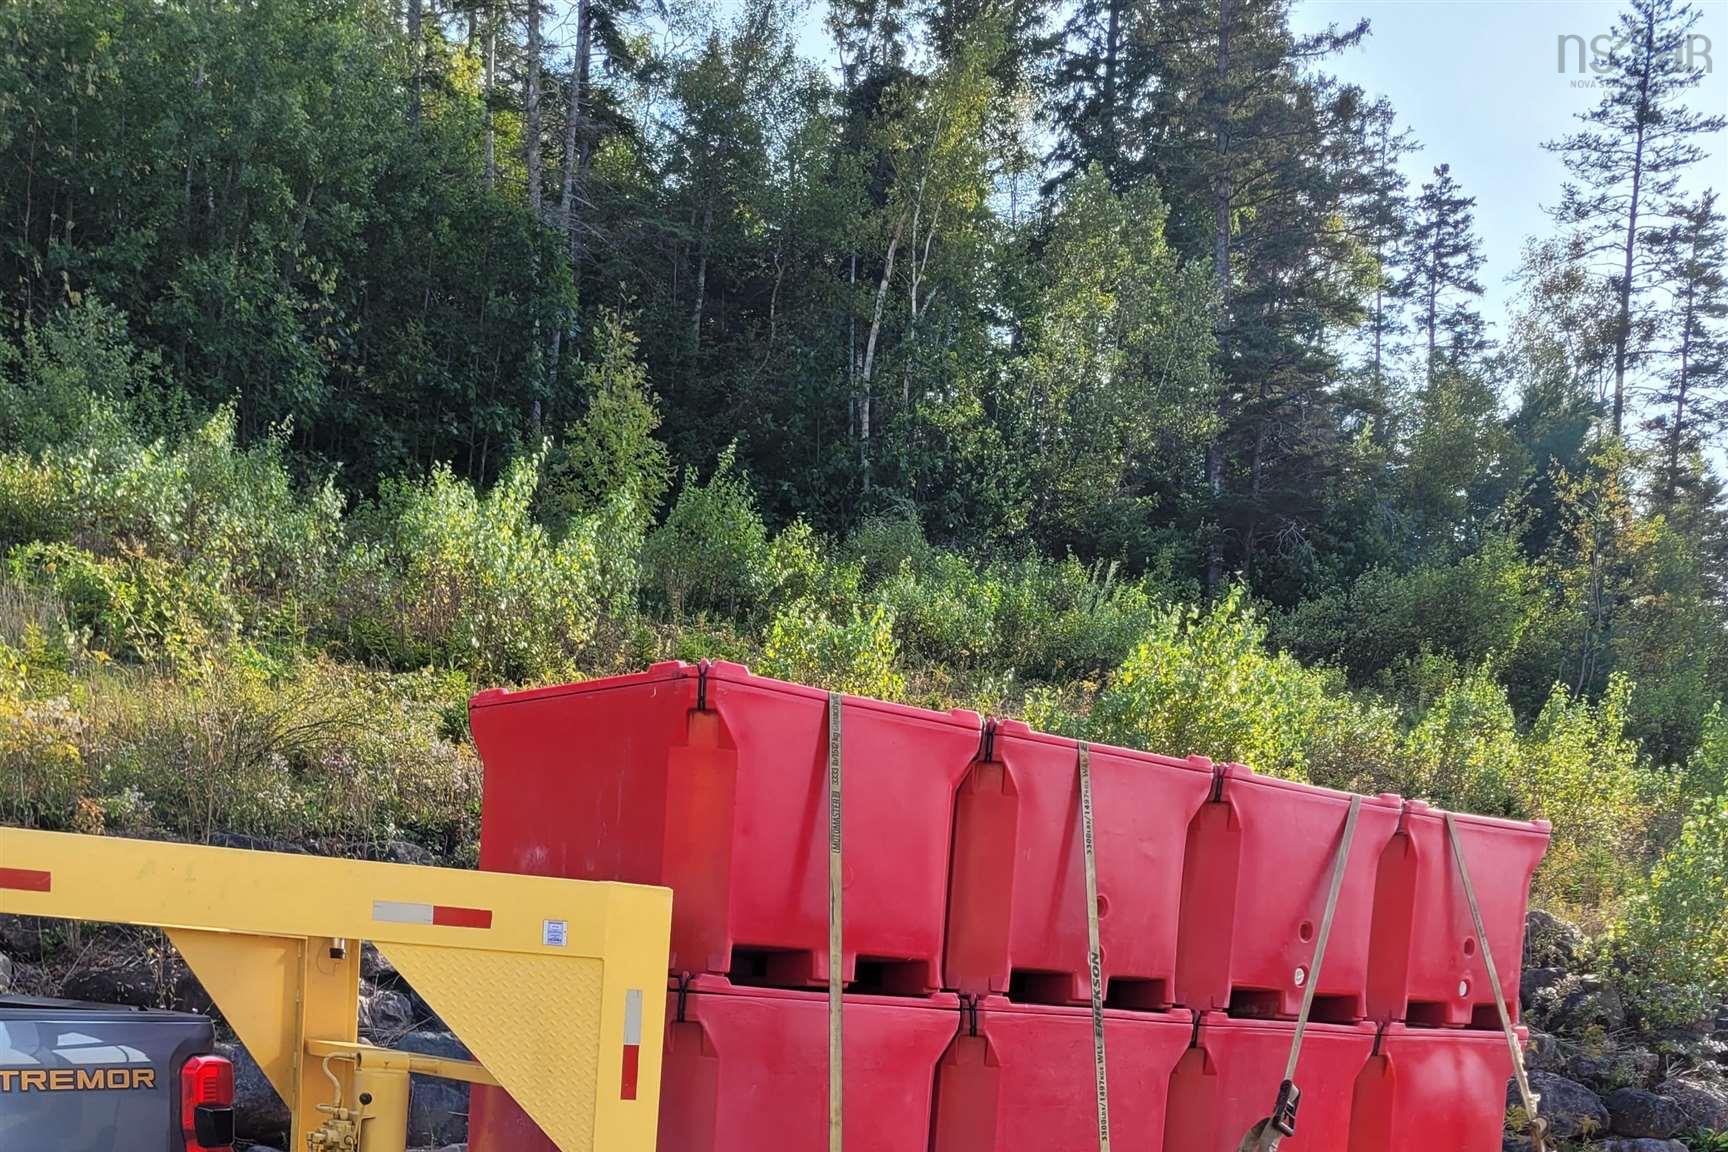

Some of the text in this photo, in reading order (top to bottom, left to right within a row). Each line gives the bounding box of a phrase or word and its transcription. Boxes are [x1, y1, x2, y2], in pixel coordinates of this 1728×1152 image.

[831, 794, 840, 854] MOTOMASTER
[1091, 952, 1103, 1038] ERICKSON
[0, 1068, 157, 1092] TREMOR
